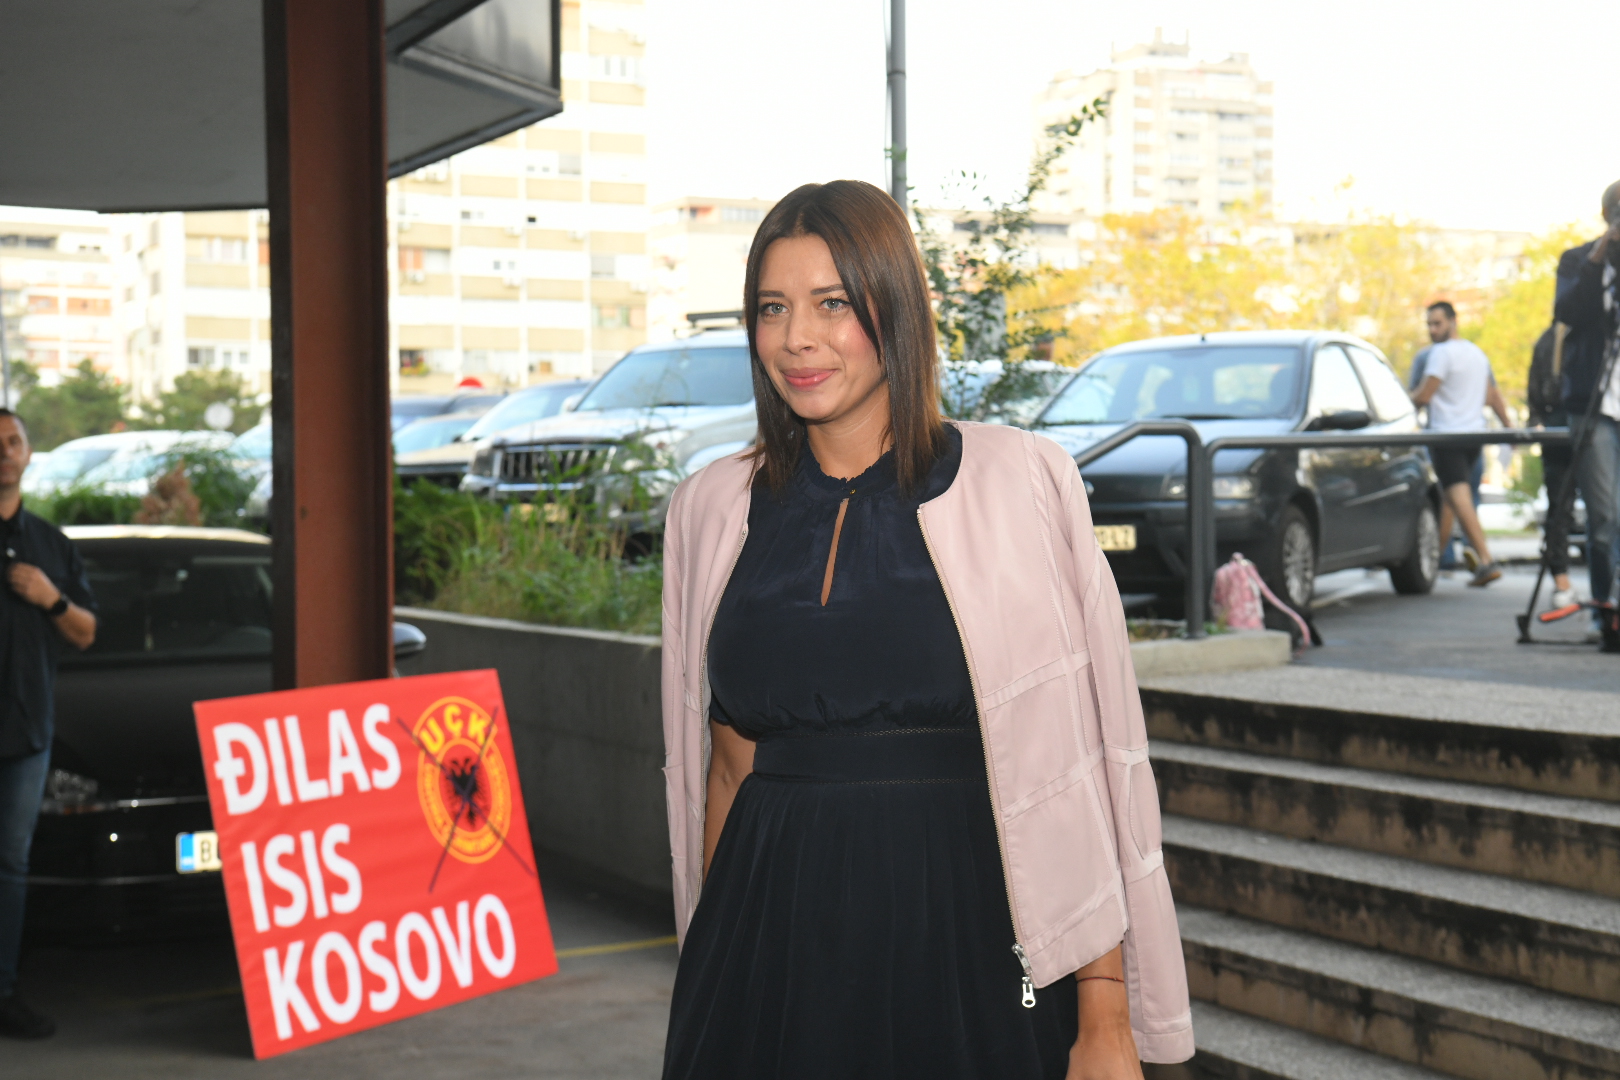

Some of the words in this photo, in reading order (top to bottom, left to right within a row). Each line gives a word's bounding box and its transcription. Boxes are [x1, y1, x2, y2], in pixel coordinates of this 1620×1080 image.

[213, 703, 402, 815] ĐILAS
[240, 823, 363, 933] ISIS
[263, 894, 516, 1040] KOSOVO
